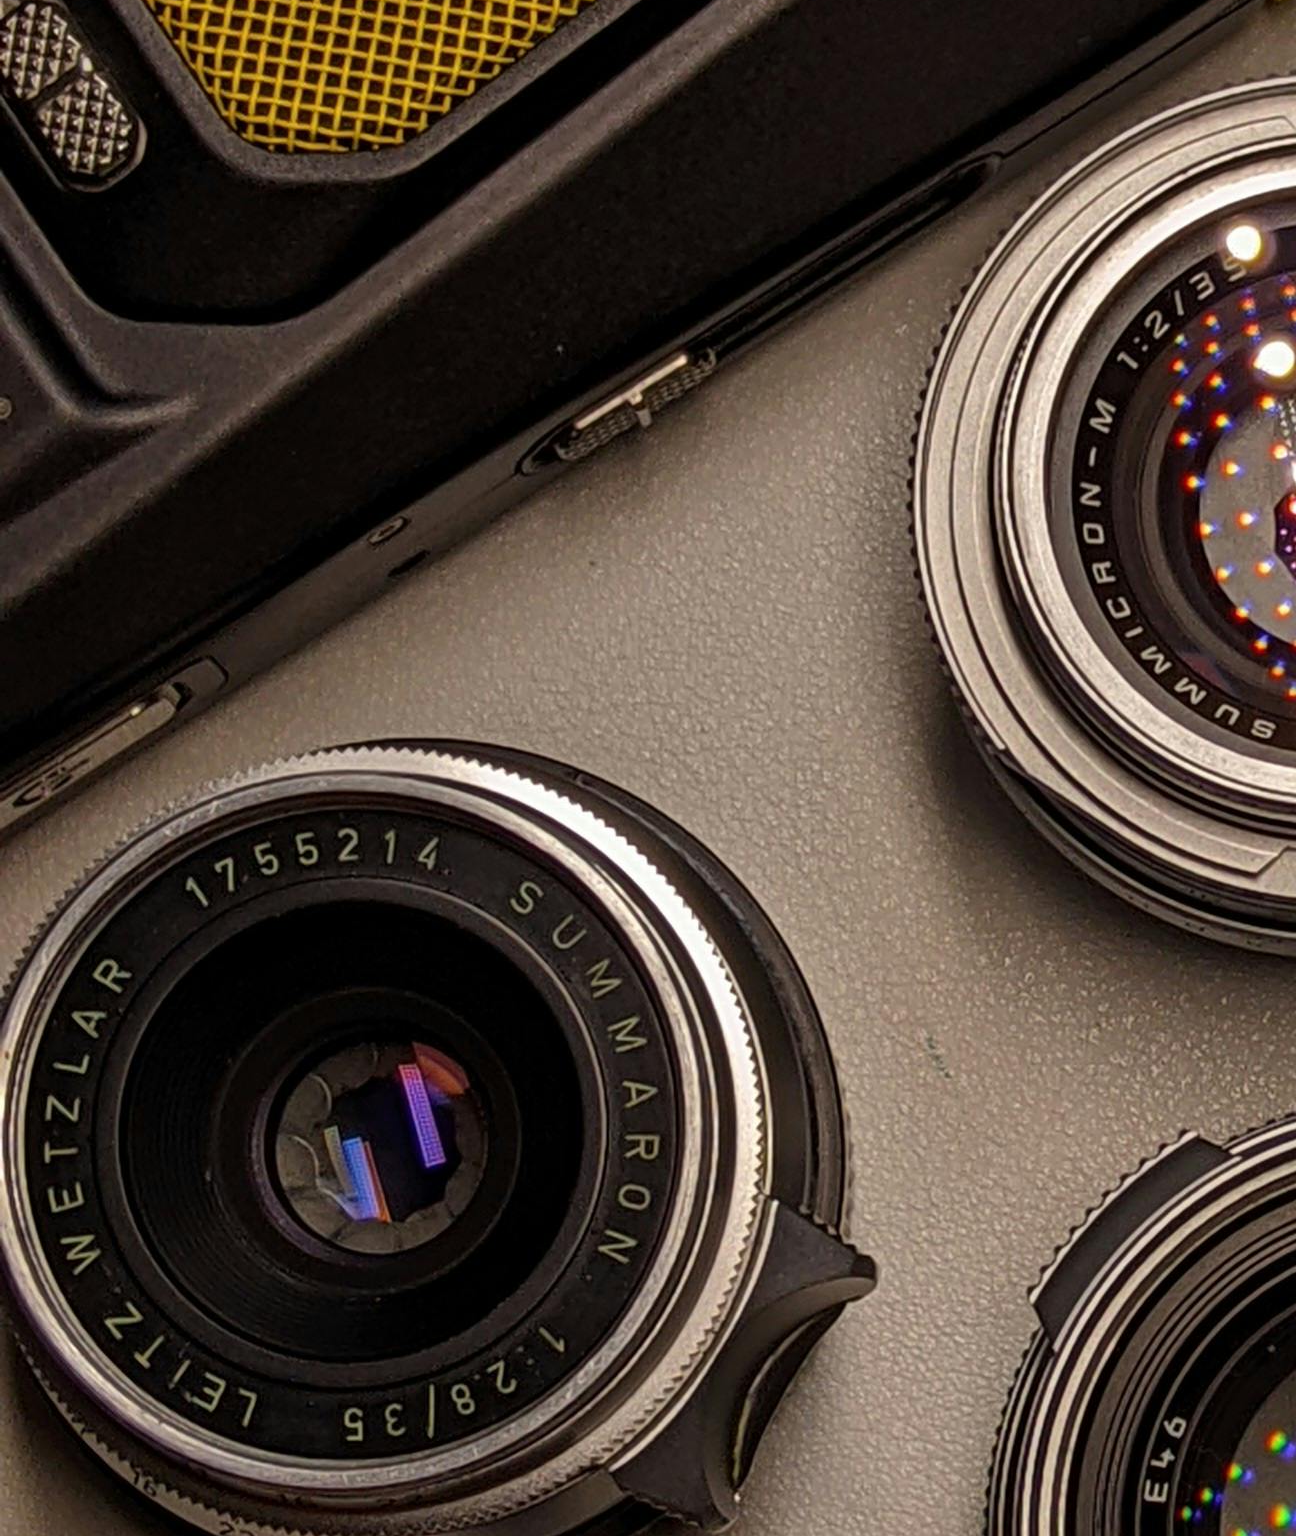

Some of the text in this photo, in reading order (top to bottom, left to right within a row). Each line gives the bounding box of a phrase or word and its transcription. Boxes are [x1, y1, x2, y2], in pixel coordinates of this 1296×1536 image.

[1079, 395, 1276, 741] SUMMICRON-M
[184, 826, 443, 910] 1755214
[45, 956, 259, 1430] LEITZ WETZLAR
[343, 879, 662, 1442] SUMMARON 1:2.8/35
[1144, 1414, 1189, 1505] E46
